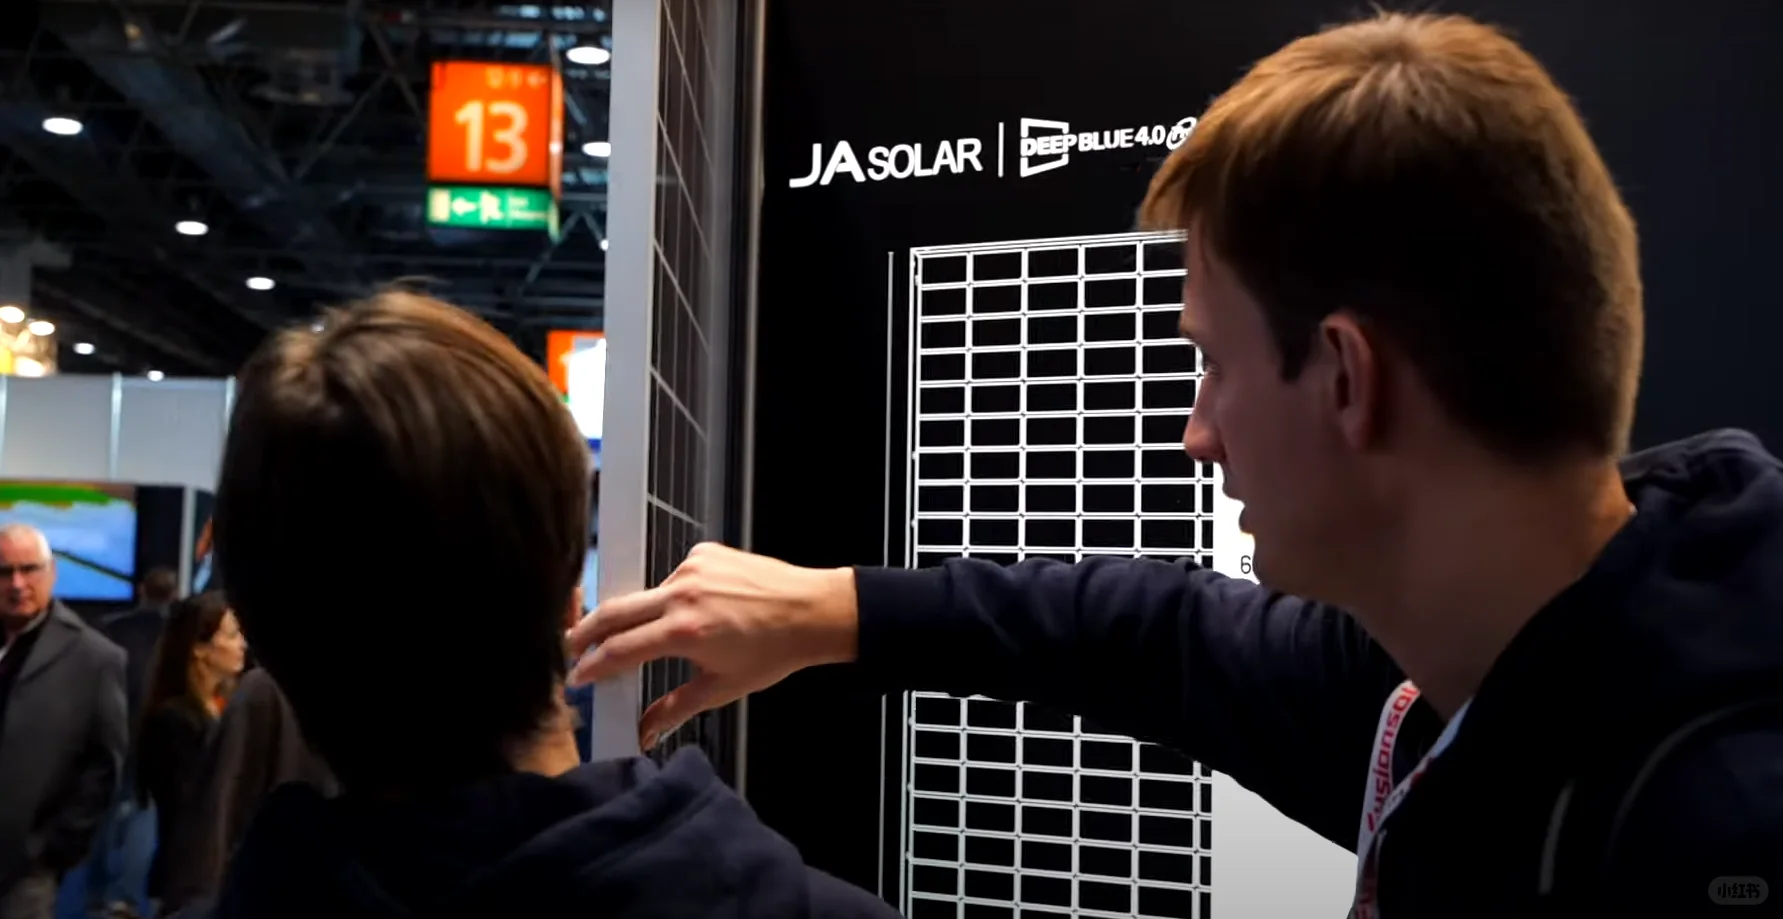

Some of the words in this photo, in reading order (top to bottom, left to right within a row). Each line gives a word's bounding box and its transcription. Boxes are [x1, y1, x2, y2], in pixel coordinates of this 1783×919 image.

[455, 100, 528, 174] 13
[1134, 125, 1166, 146] 4.0
[789, 140, 866, 188] JA
[867, 138, 983, 181] SOLAR
